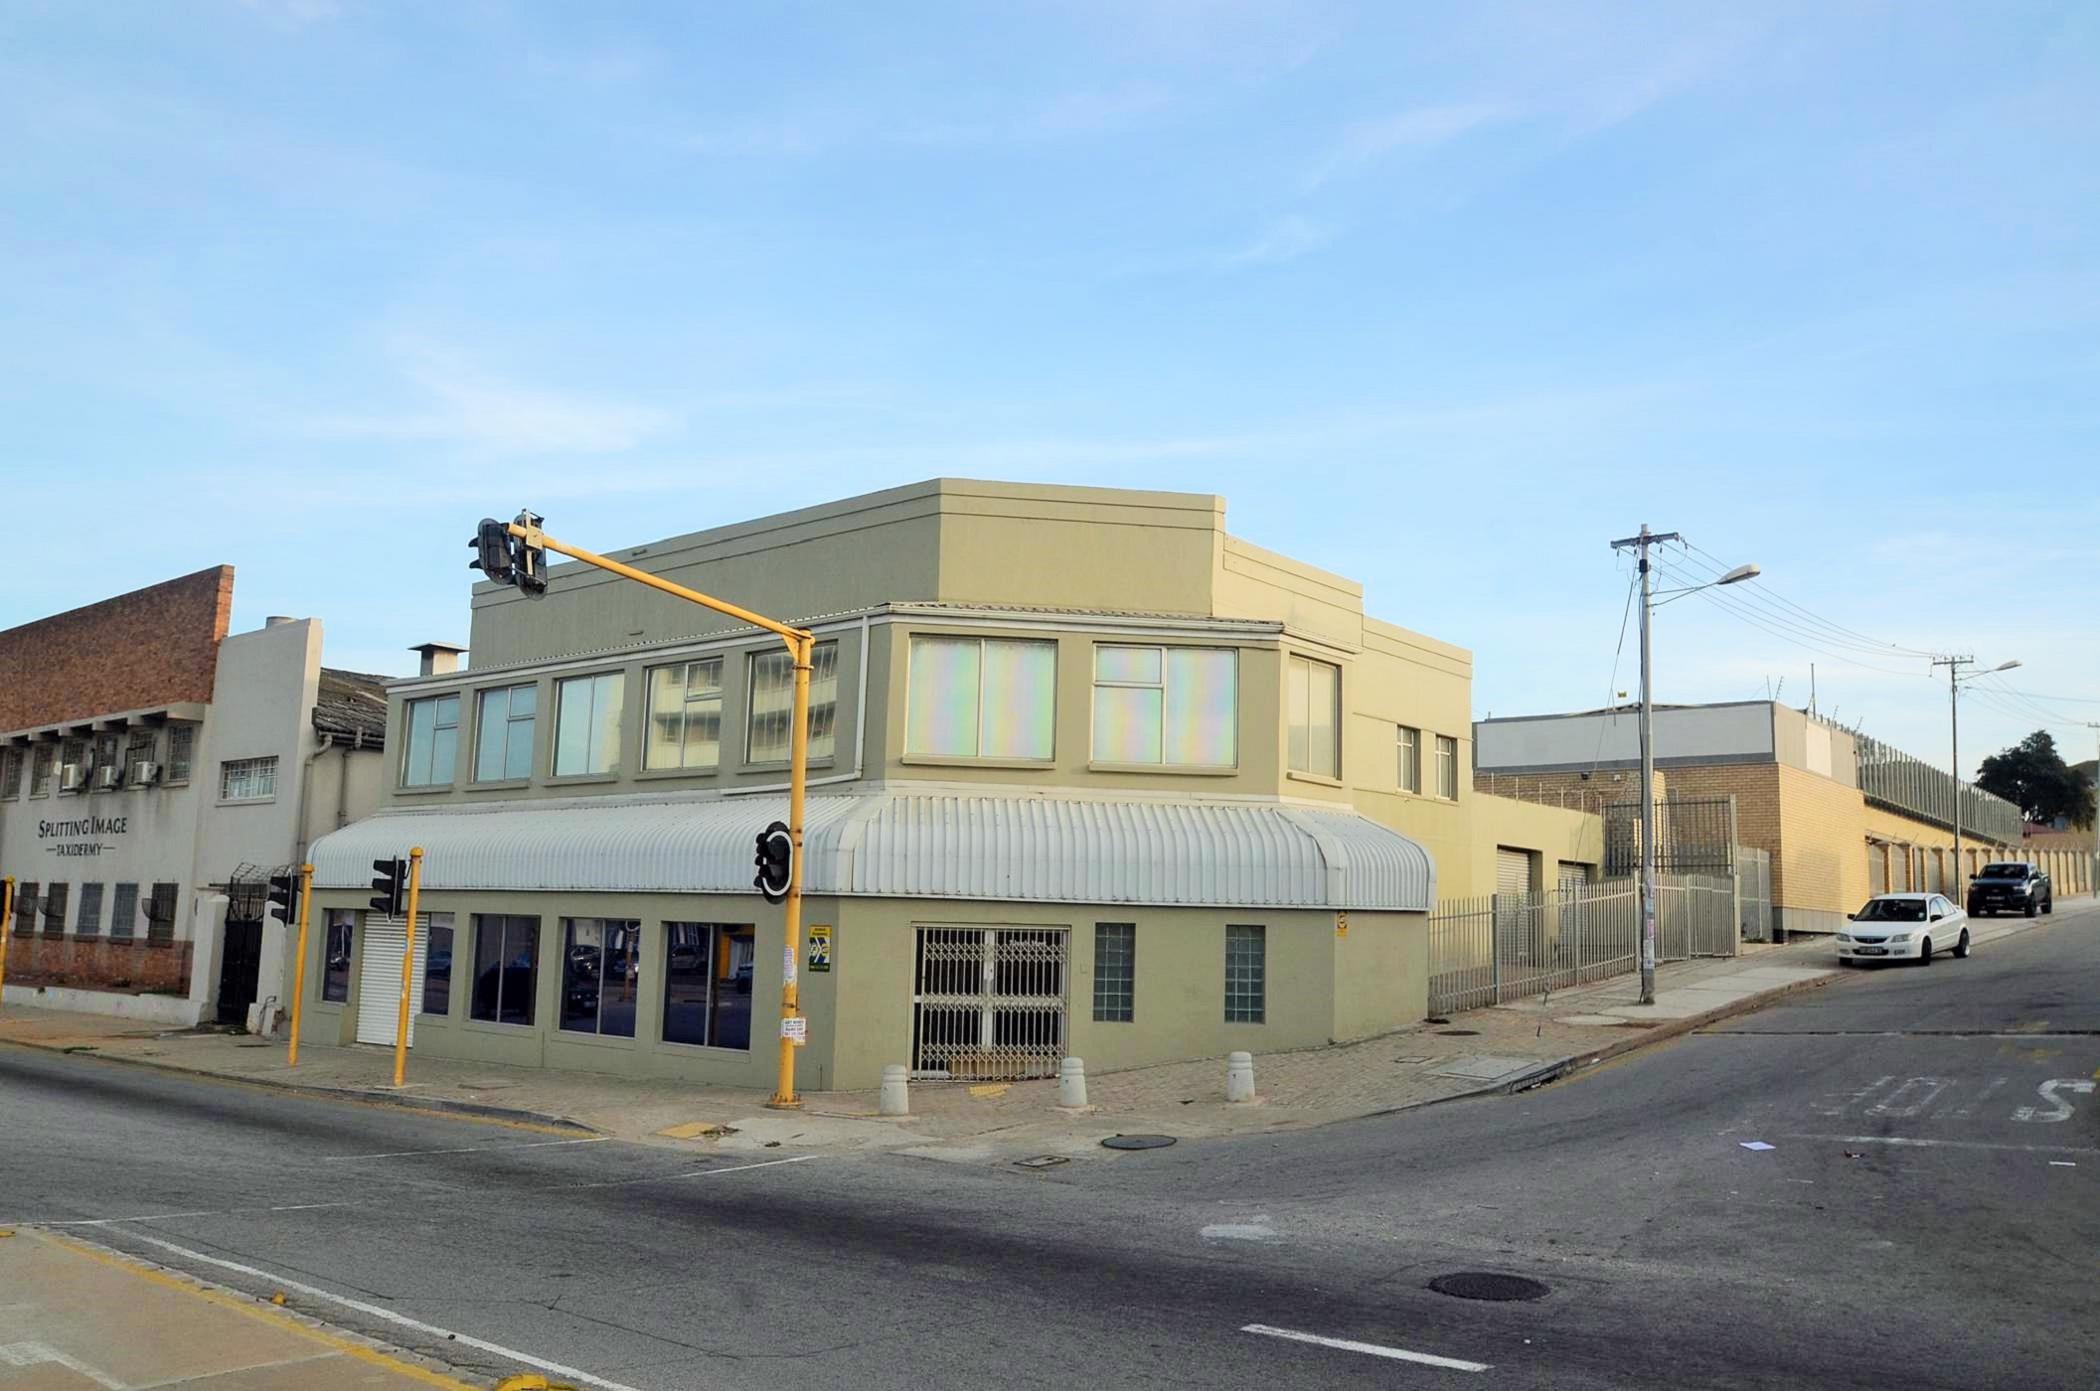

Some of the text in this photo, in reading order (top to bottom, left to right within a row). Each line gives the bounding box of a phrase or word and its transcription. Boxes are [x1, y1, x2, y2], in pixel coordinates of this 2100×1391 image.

[38, 816, 128, 838] SPLITTING IMAGE
[56, 843, 103, 857] TAXIDERMY
